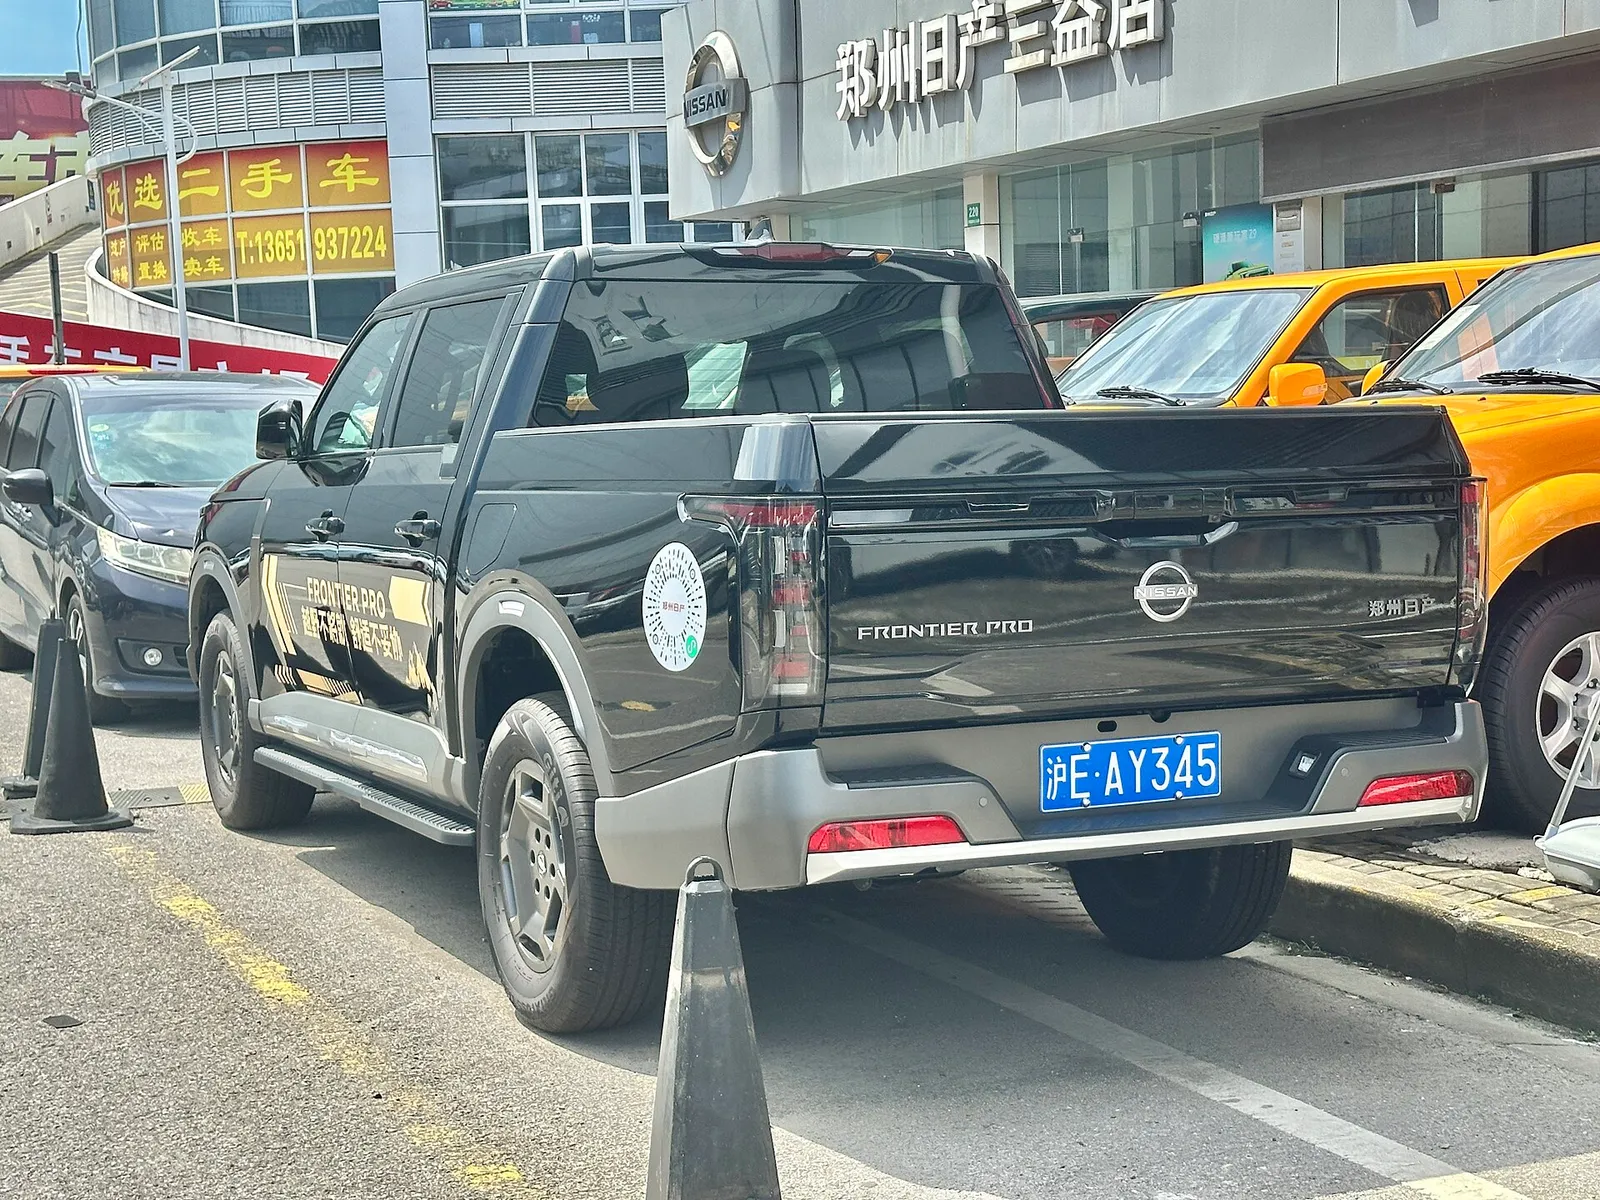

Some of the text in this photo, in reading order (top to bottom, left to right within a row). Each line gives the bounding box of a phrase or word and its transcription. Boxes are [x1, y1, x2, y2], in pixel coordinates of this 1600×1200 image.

[684, 88, 728, 119] NISSAN
[106, 153, 380, 216] 优选二手车
[968, 206, 979, 217] 220
[136, 231, 165, 253] 评估
[181, 226, 223, 248] 收车
[138, 259, 168, 281] 置换
[184, 255, 225, 276] 卖车
[307, 576, 386, 619] FRONTIER PRO
[1135, 583, 1198, 600] NISSAN
[1368, 597, 1436, 617] 郑州日产
[857, 618, 1034, 640] FRONTIER PRO
